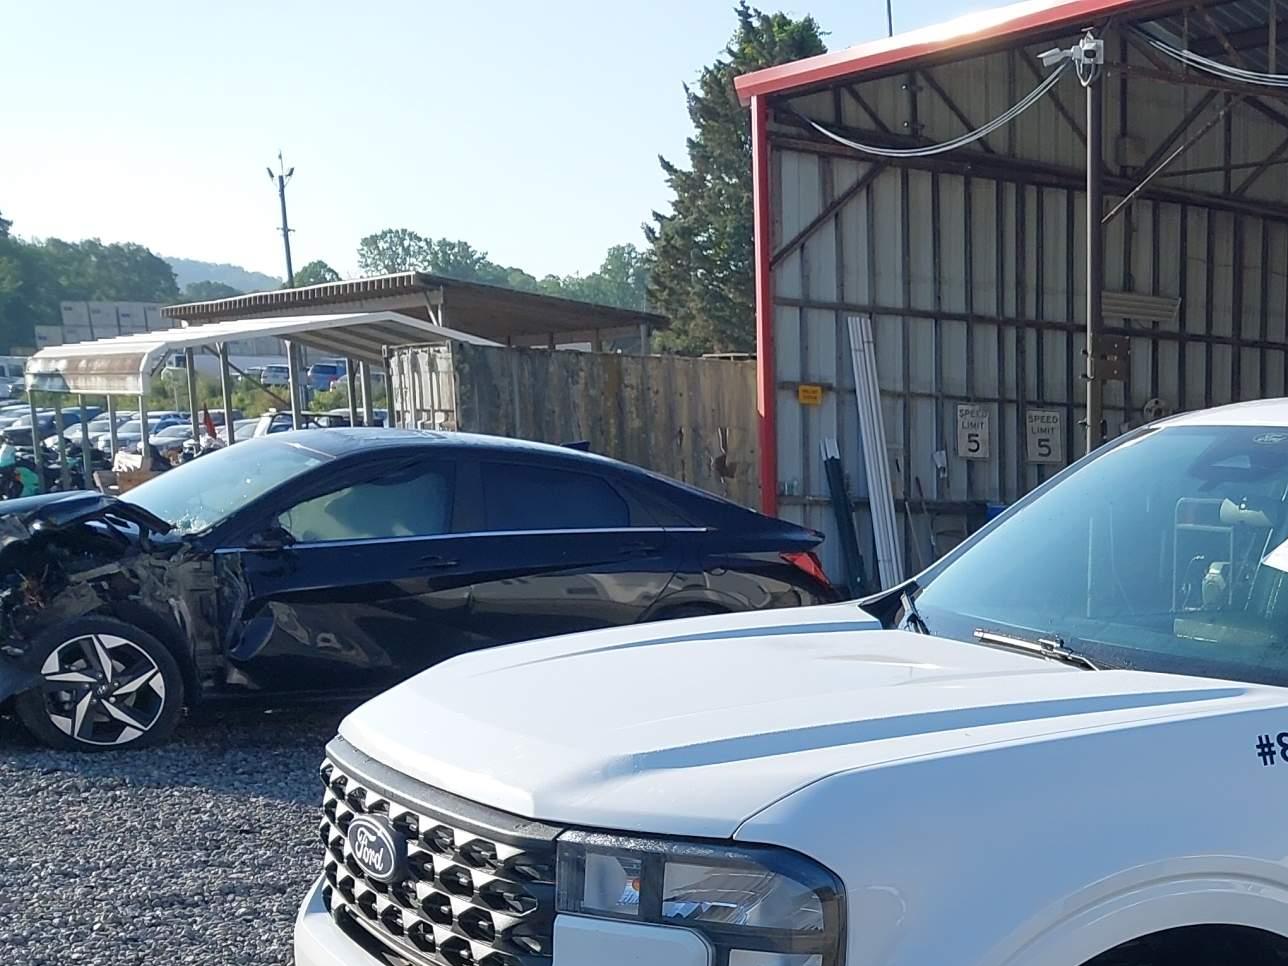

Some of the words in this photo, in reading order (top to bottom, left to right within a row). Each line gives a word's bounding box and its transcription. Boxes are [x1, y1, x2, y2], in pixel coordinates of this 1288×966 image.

[959, 408, 989, 419] SPEED
[962, 420, 985, 430] LIMIT
[1028, 415, 1058, 424] SPEED
[1031, 427, 1056, 435] LIMIT
[967, 433, 980, 453] 5
[1038, 438, 1051, 457] 5
[355, 827, 384, 871] Ford
